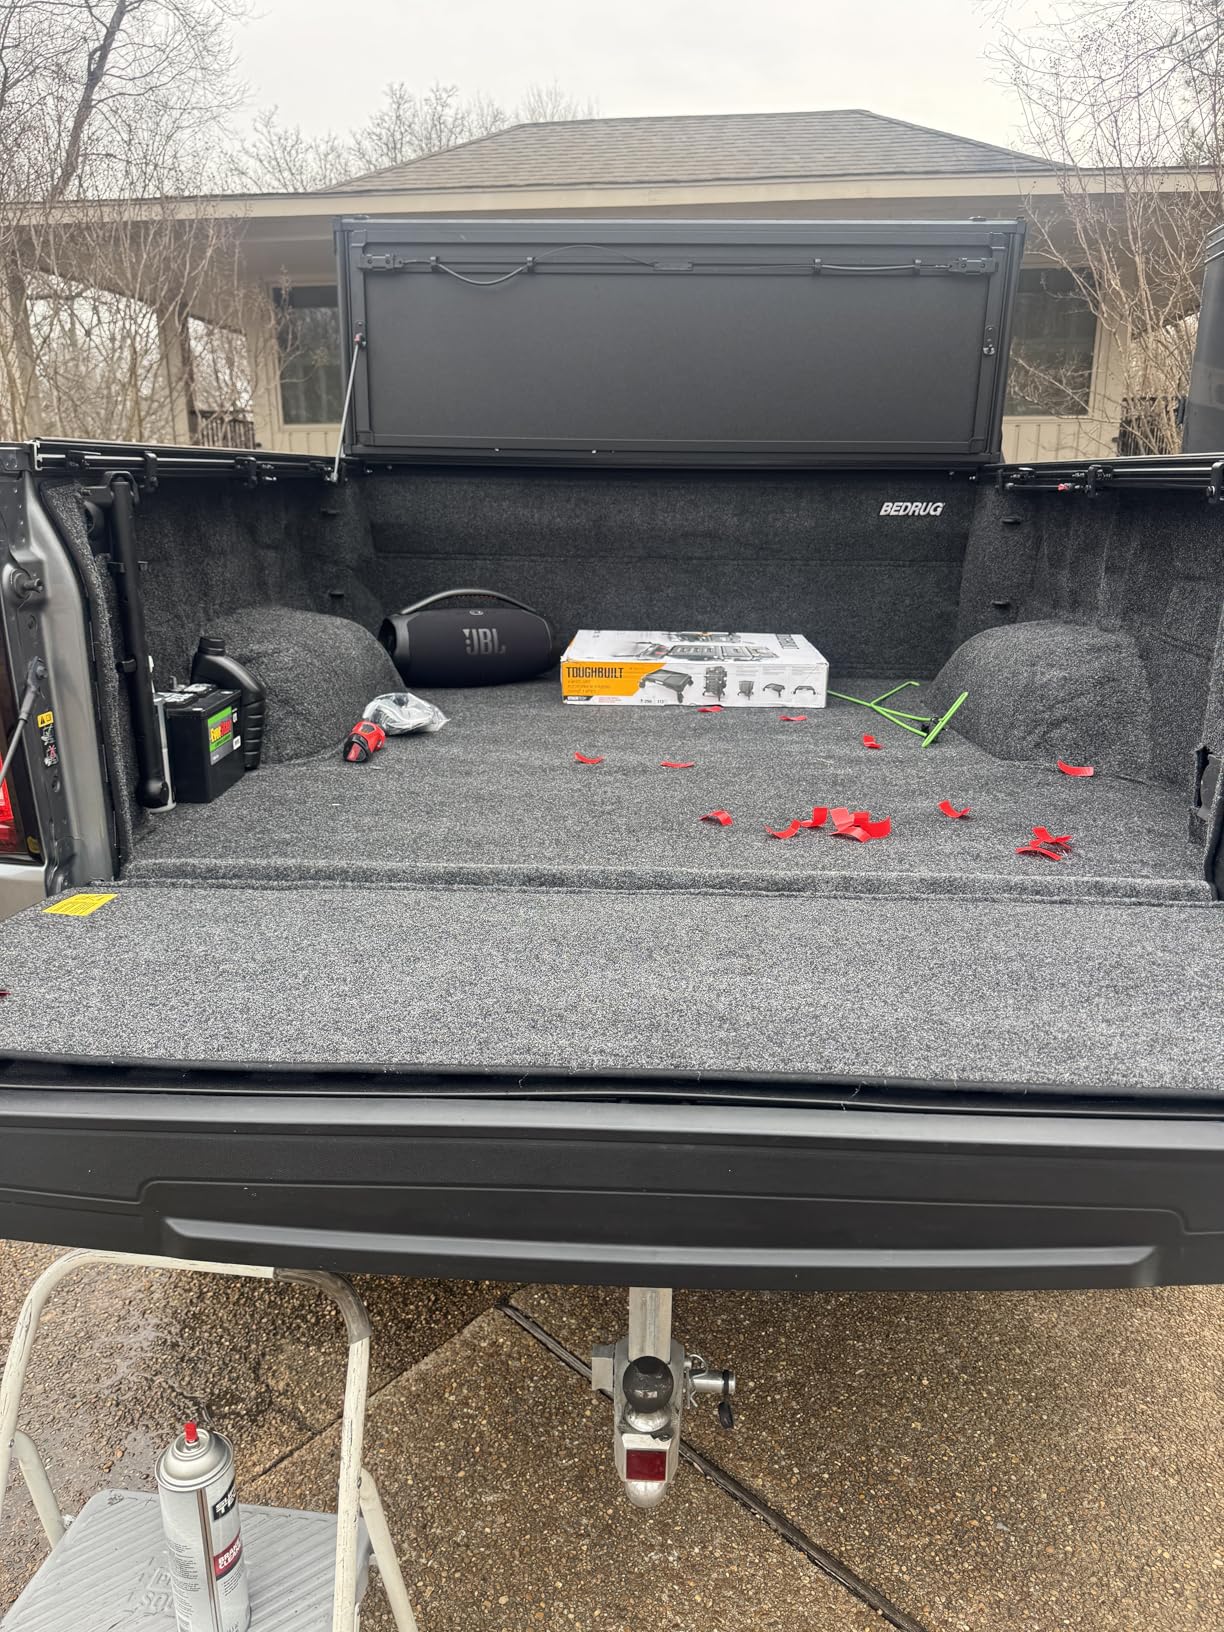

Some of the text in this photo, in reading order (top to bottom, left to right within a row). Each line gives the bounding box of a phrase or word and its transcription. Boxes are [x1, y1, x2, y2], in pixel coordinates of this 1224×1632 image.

[879, 502, 944, 516] BEDRUG
[462, 628, 506, 655] JBL
[566, 666, 624, 679] TOUGHBUILT
